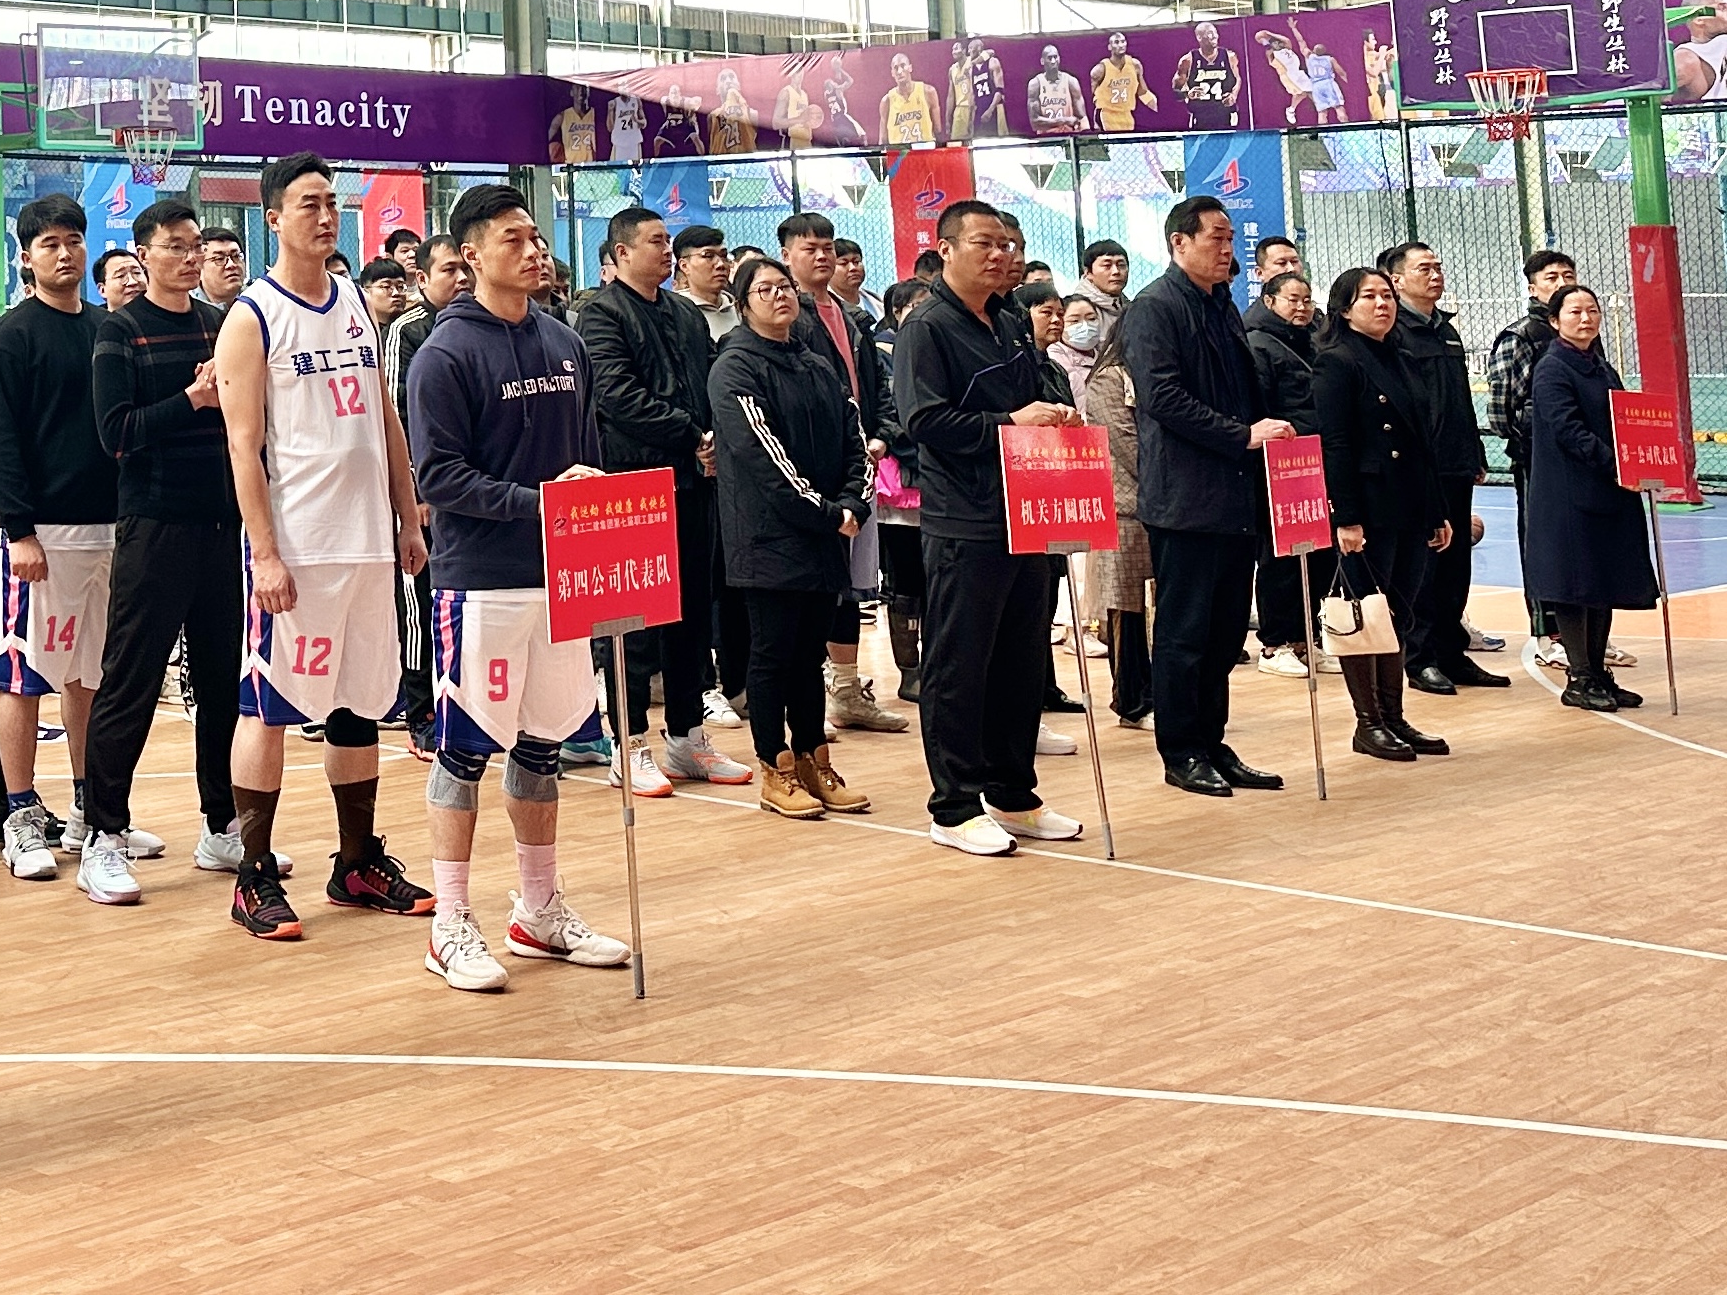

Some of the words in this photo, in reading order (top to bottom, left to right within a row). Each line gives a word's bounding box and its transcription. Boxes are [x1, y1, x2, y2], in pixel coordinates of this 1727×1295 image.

[1429, 6, 1457, 85] 野生丛林
[976, 81, 991, 98] 24
[1110, 88, 1128, 104] 24
[234, 84, 412, 138] Tenacity
[621, 119, 634, 131] 24
[571, 134, 592, 151] 24
[725, 123, 742, 149] 24
[900, 122, 923, 142] 24
[291, 345, 377, 377] 建工二建
[327, 374, 366, 418] 12
[556, 553, 672, 603] 第四公司代表队
[43, 614, 75, 653] 14
[291, 635, 333, 677] 12
[487, 658, 509, 702] 9
